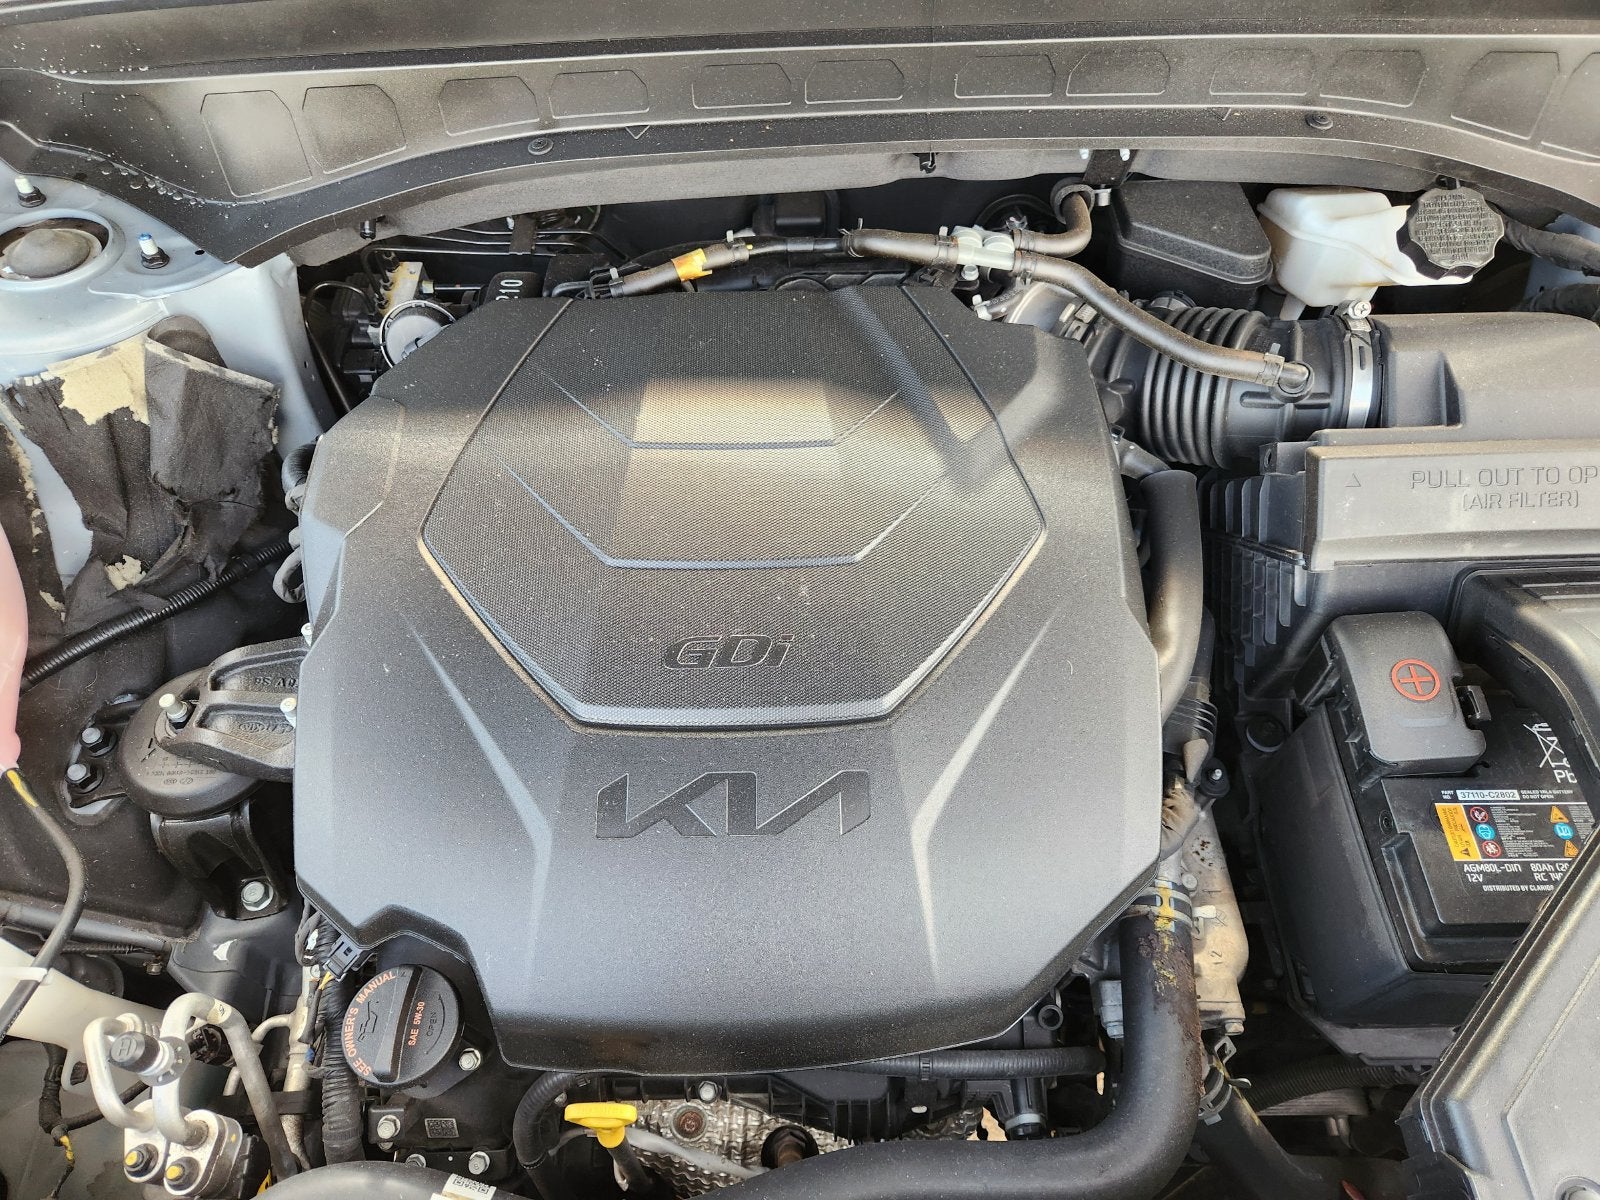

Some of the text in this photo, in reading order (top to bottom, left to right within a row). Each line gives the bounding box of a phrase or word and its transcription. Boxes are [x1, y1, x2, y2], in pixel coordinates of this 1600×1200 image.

[1410, 465, 1600, 489] PULL OUT TO OP
[1463, 490, 1580, 511] (AIR FILTER)
[664, 633, 795, 669] GDi
[1553, 769, 1578, 783] Pb
[1460, 791, 1517, 799] 37110-C2802
[1530, 862, 1554, 872] 80Ah
[1466, 873, 1483, 883] 12V
[1533, 872, 1548, 881] RC
[1482, 884, 1520, 892] DISTRIBUTED
[1520, 884, 1528, 892] BY
[344, 971, 396, 1076] SEE OWNER'S MANUAL
[408, 1001, 425, 1046] SAE 5W-30
[426, 1012, 437, 1036] OPEN
